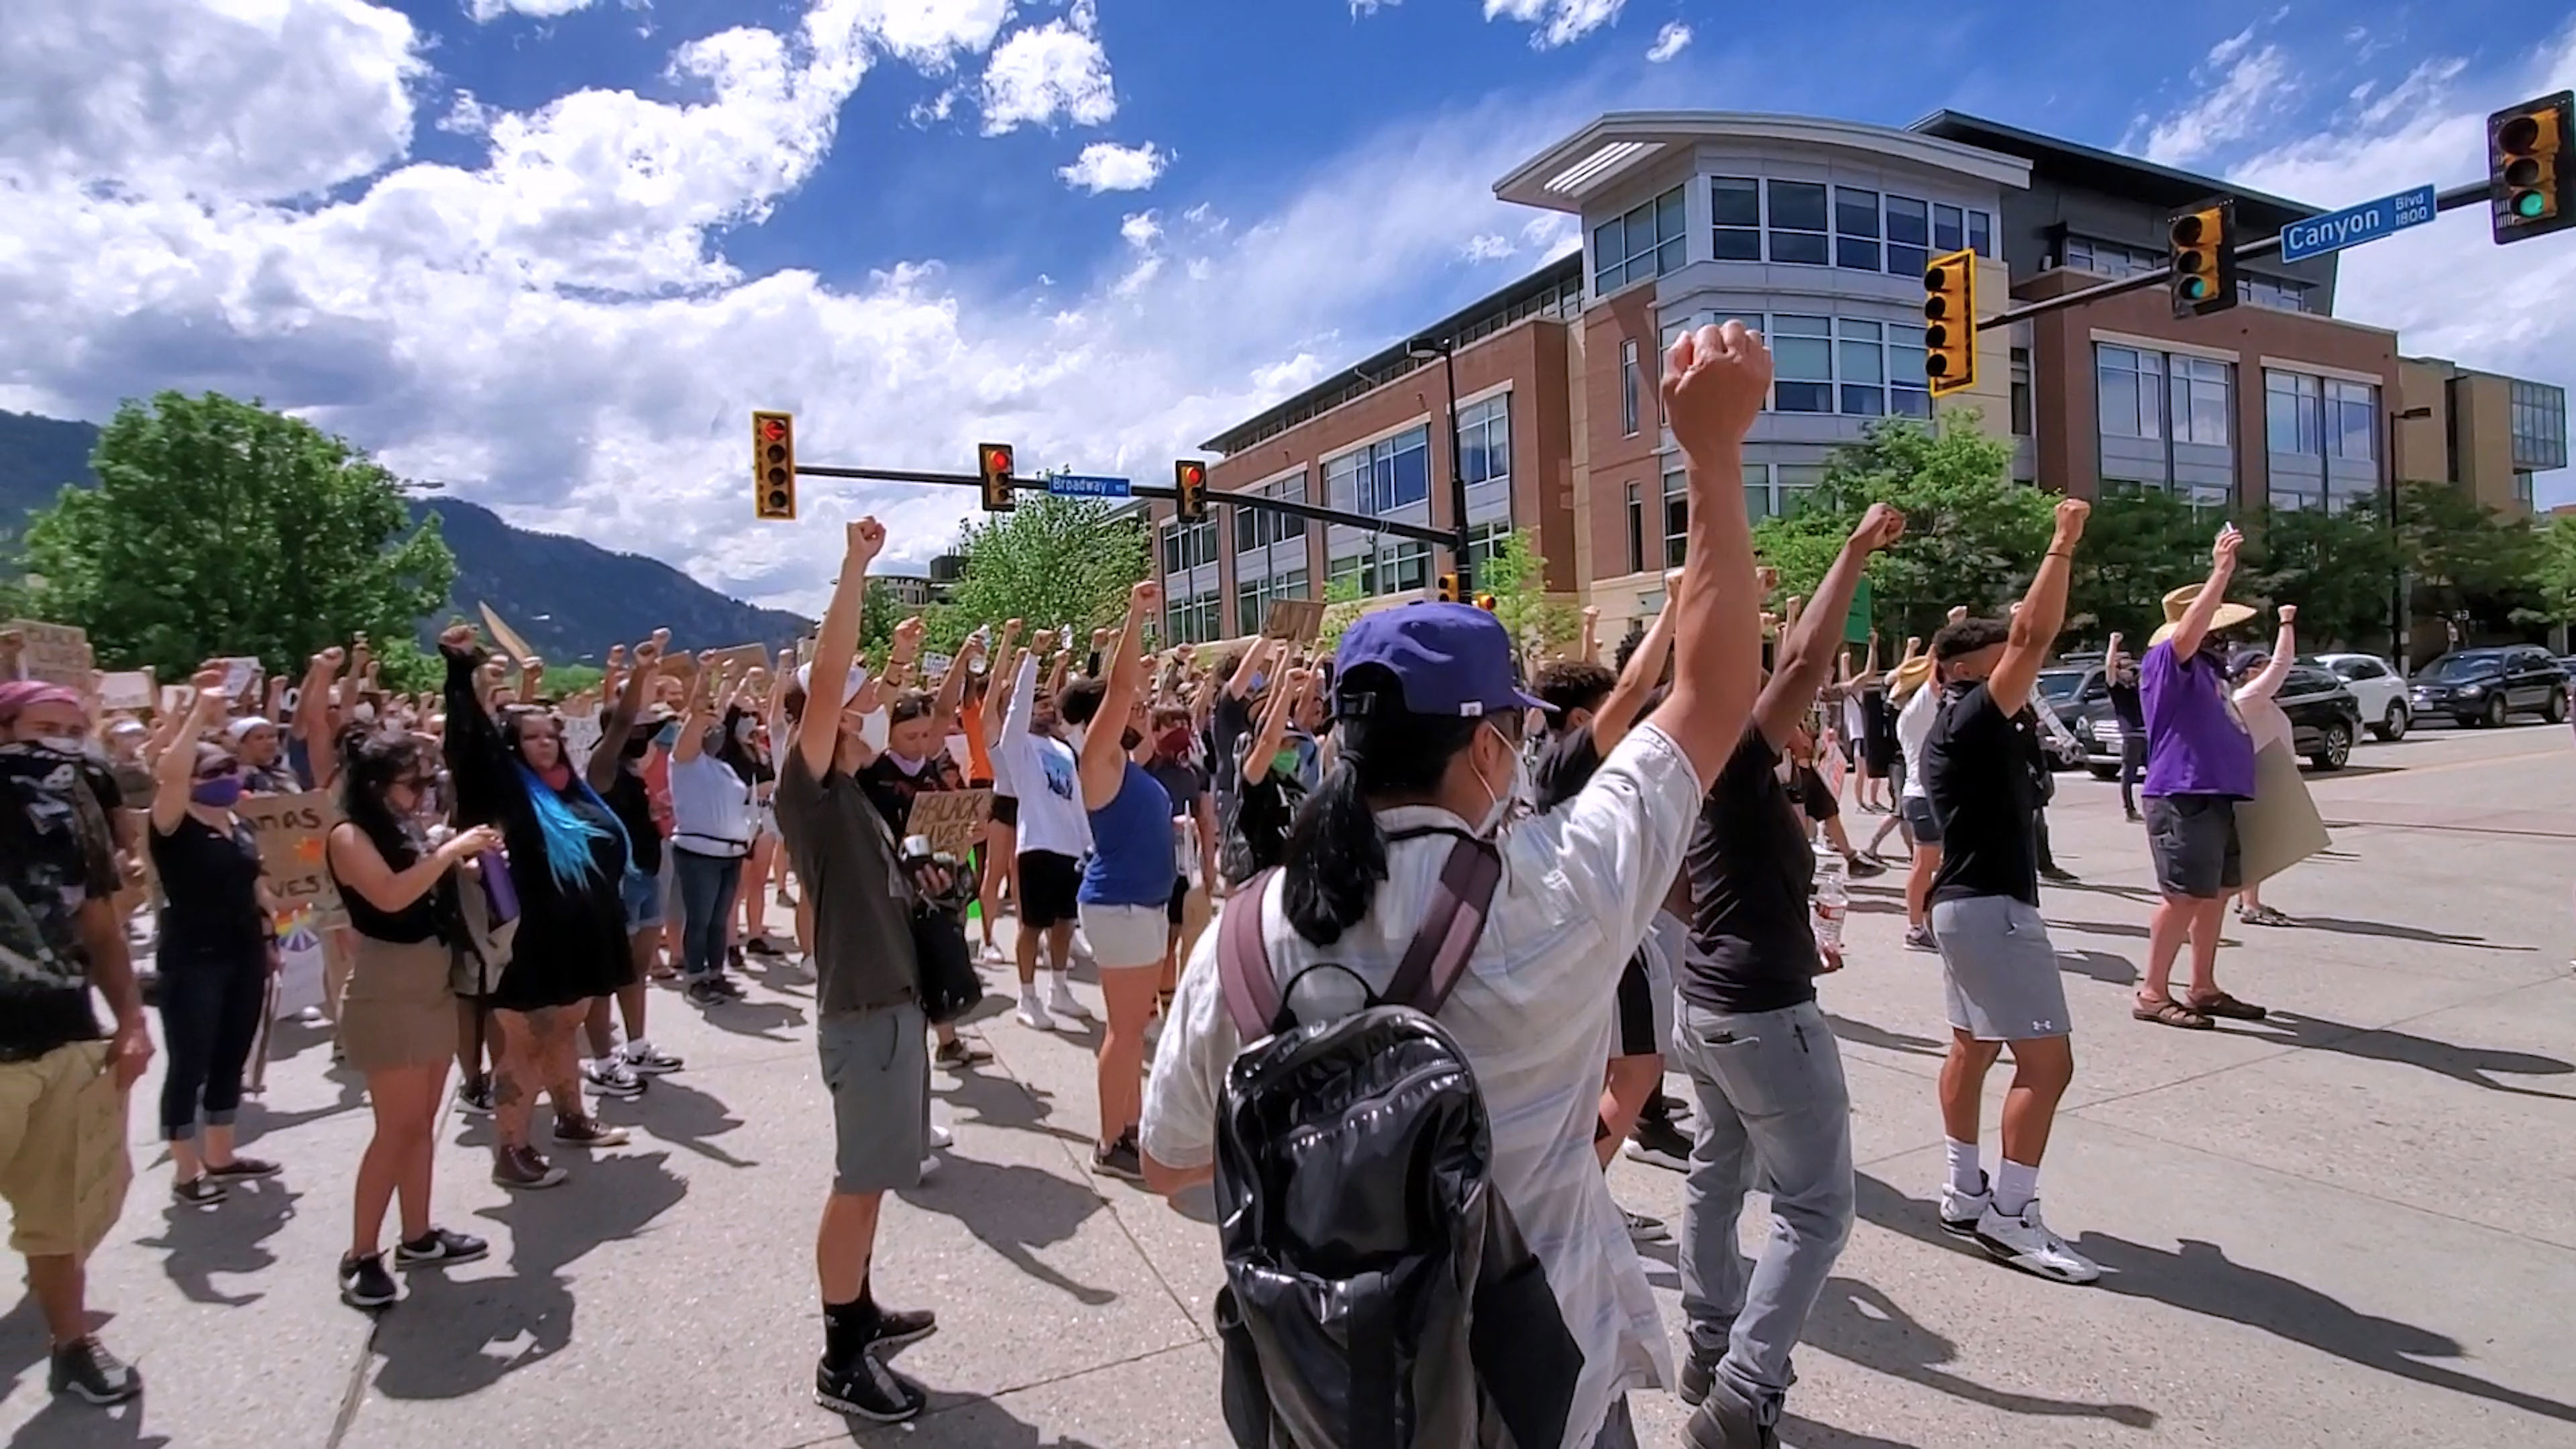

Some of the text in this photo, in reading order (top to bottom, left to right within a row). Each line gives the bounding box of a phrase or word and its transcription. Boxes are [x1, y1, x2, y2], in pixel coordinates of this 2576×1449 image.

[2395, 193, 2424, 211] Blvd
[2395, 206, 2428, 227] 1800
[2289, 209, 2379, 250] Canyon
[1053, 477, 1107, 494] Broadway
